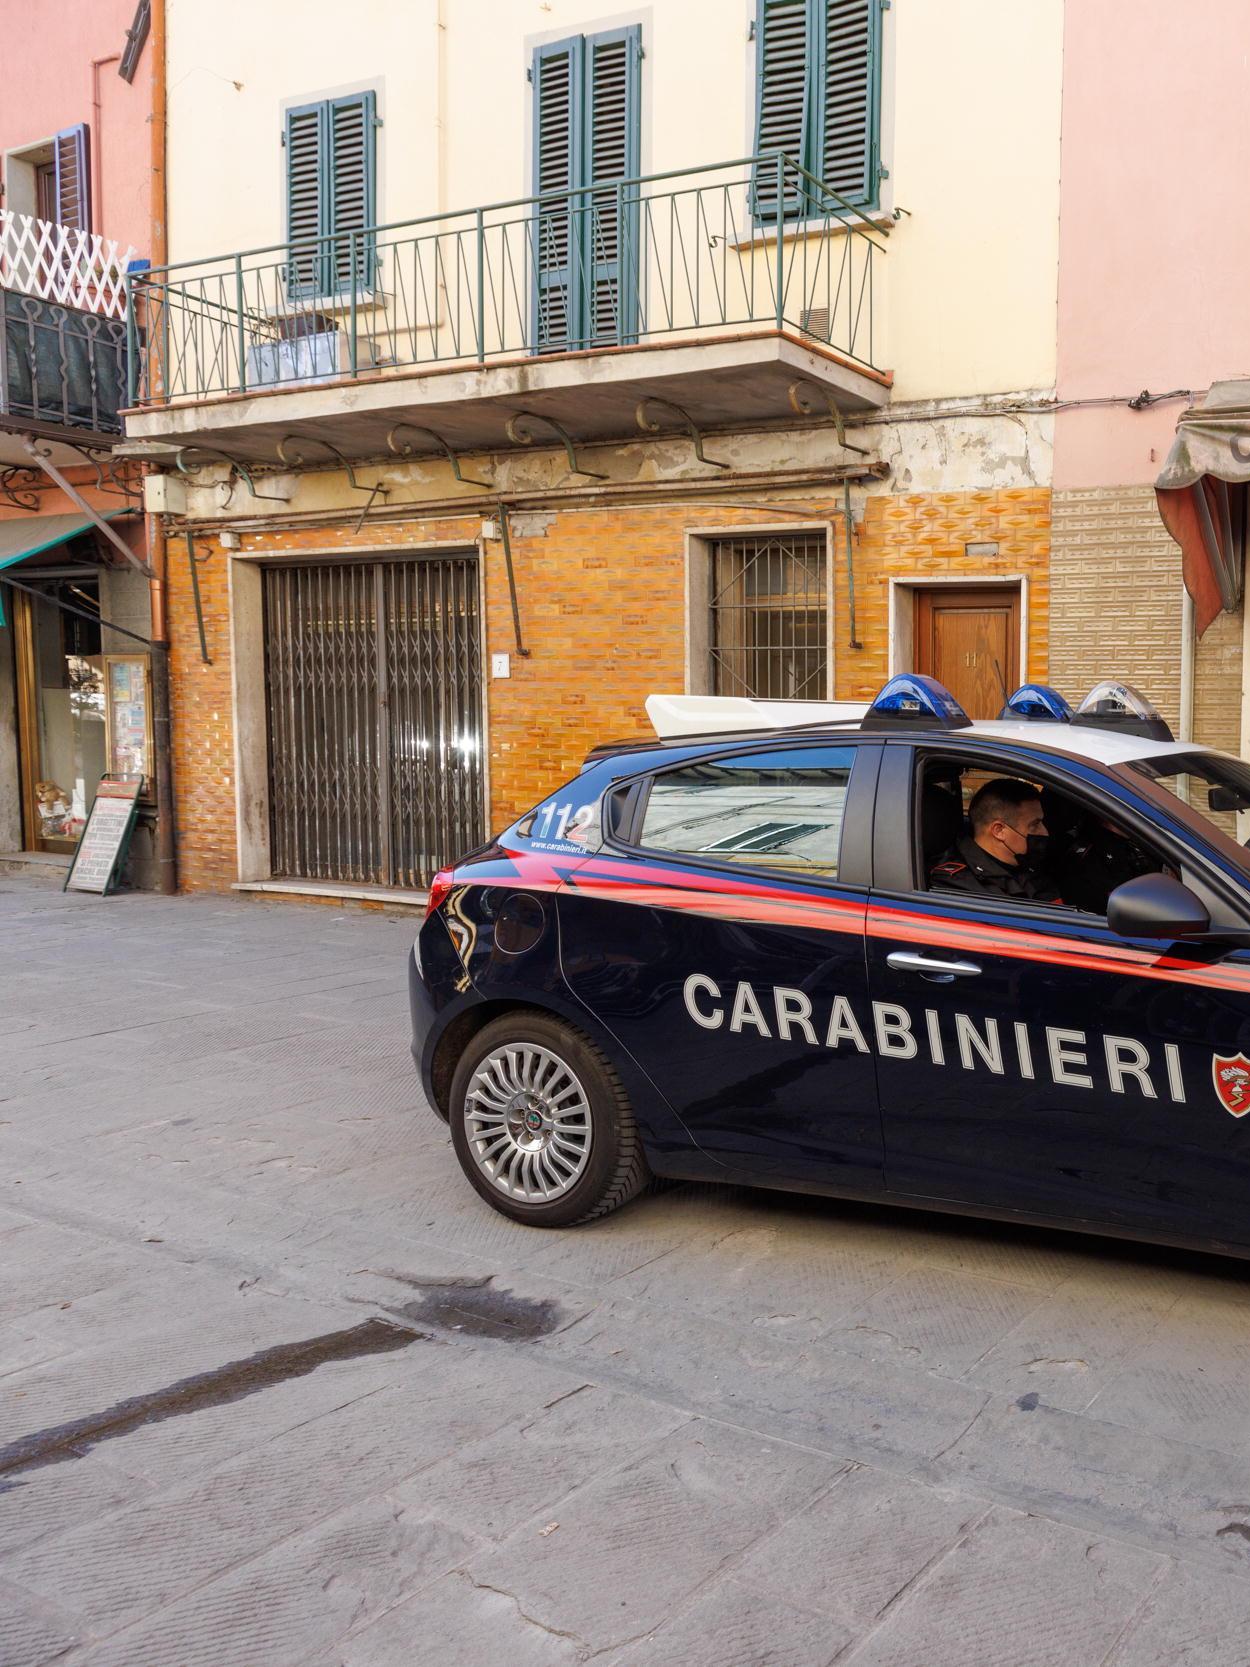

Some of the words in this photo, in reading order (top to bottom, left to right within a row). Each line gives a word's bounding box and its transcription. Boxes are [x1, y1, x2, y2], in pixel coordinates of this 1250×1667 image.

[964, 650, 977, 668] 11
[540, 802, 594, 843] 112
[531, 841, 587, 854] www.carabinieri.it
[683, 972, 1187, 1104] CARABINIERI
